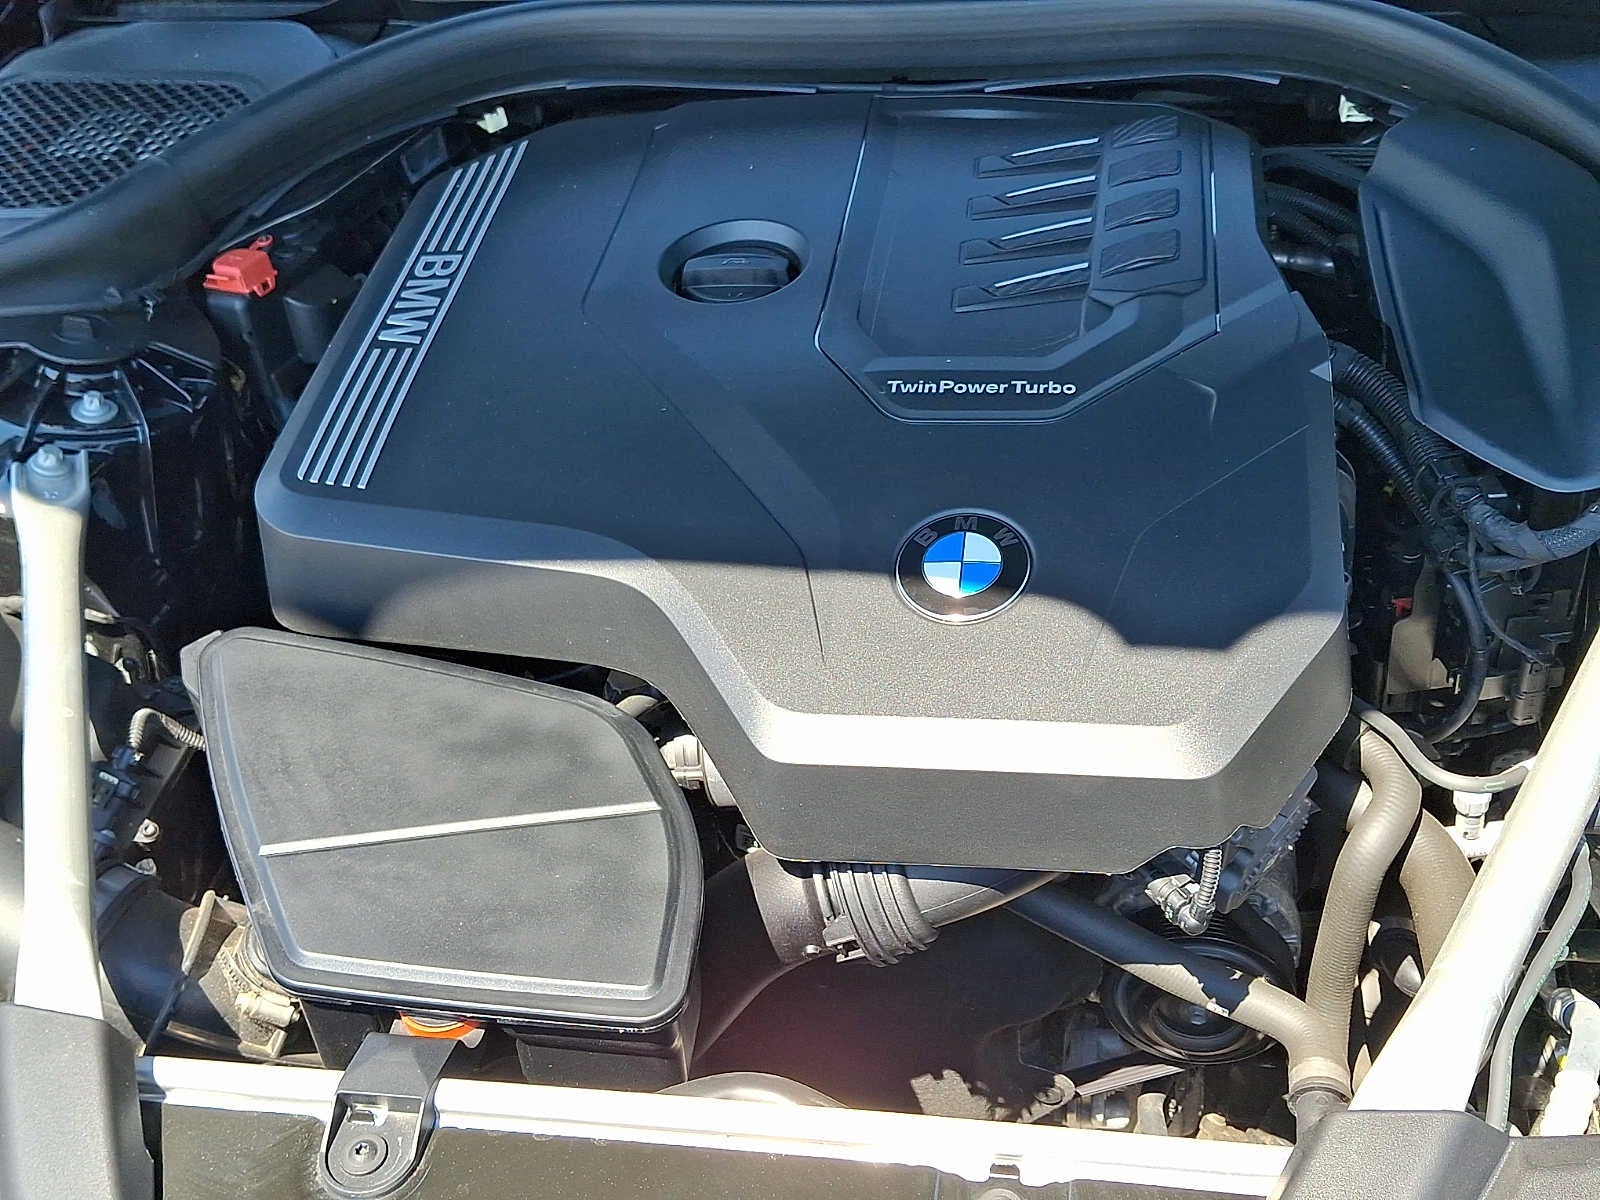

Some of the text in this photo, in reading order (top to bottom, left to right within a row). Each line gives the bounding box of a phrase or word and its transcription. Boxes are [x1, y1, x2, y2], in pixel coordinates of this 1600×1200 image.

[378, 254, 463, 345] BMW
[887, 380, 1076, 394] TwinPower Turbo
[913, 516, 1020, 548] BMW
